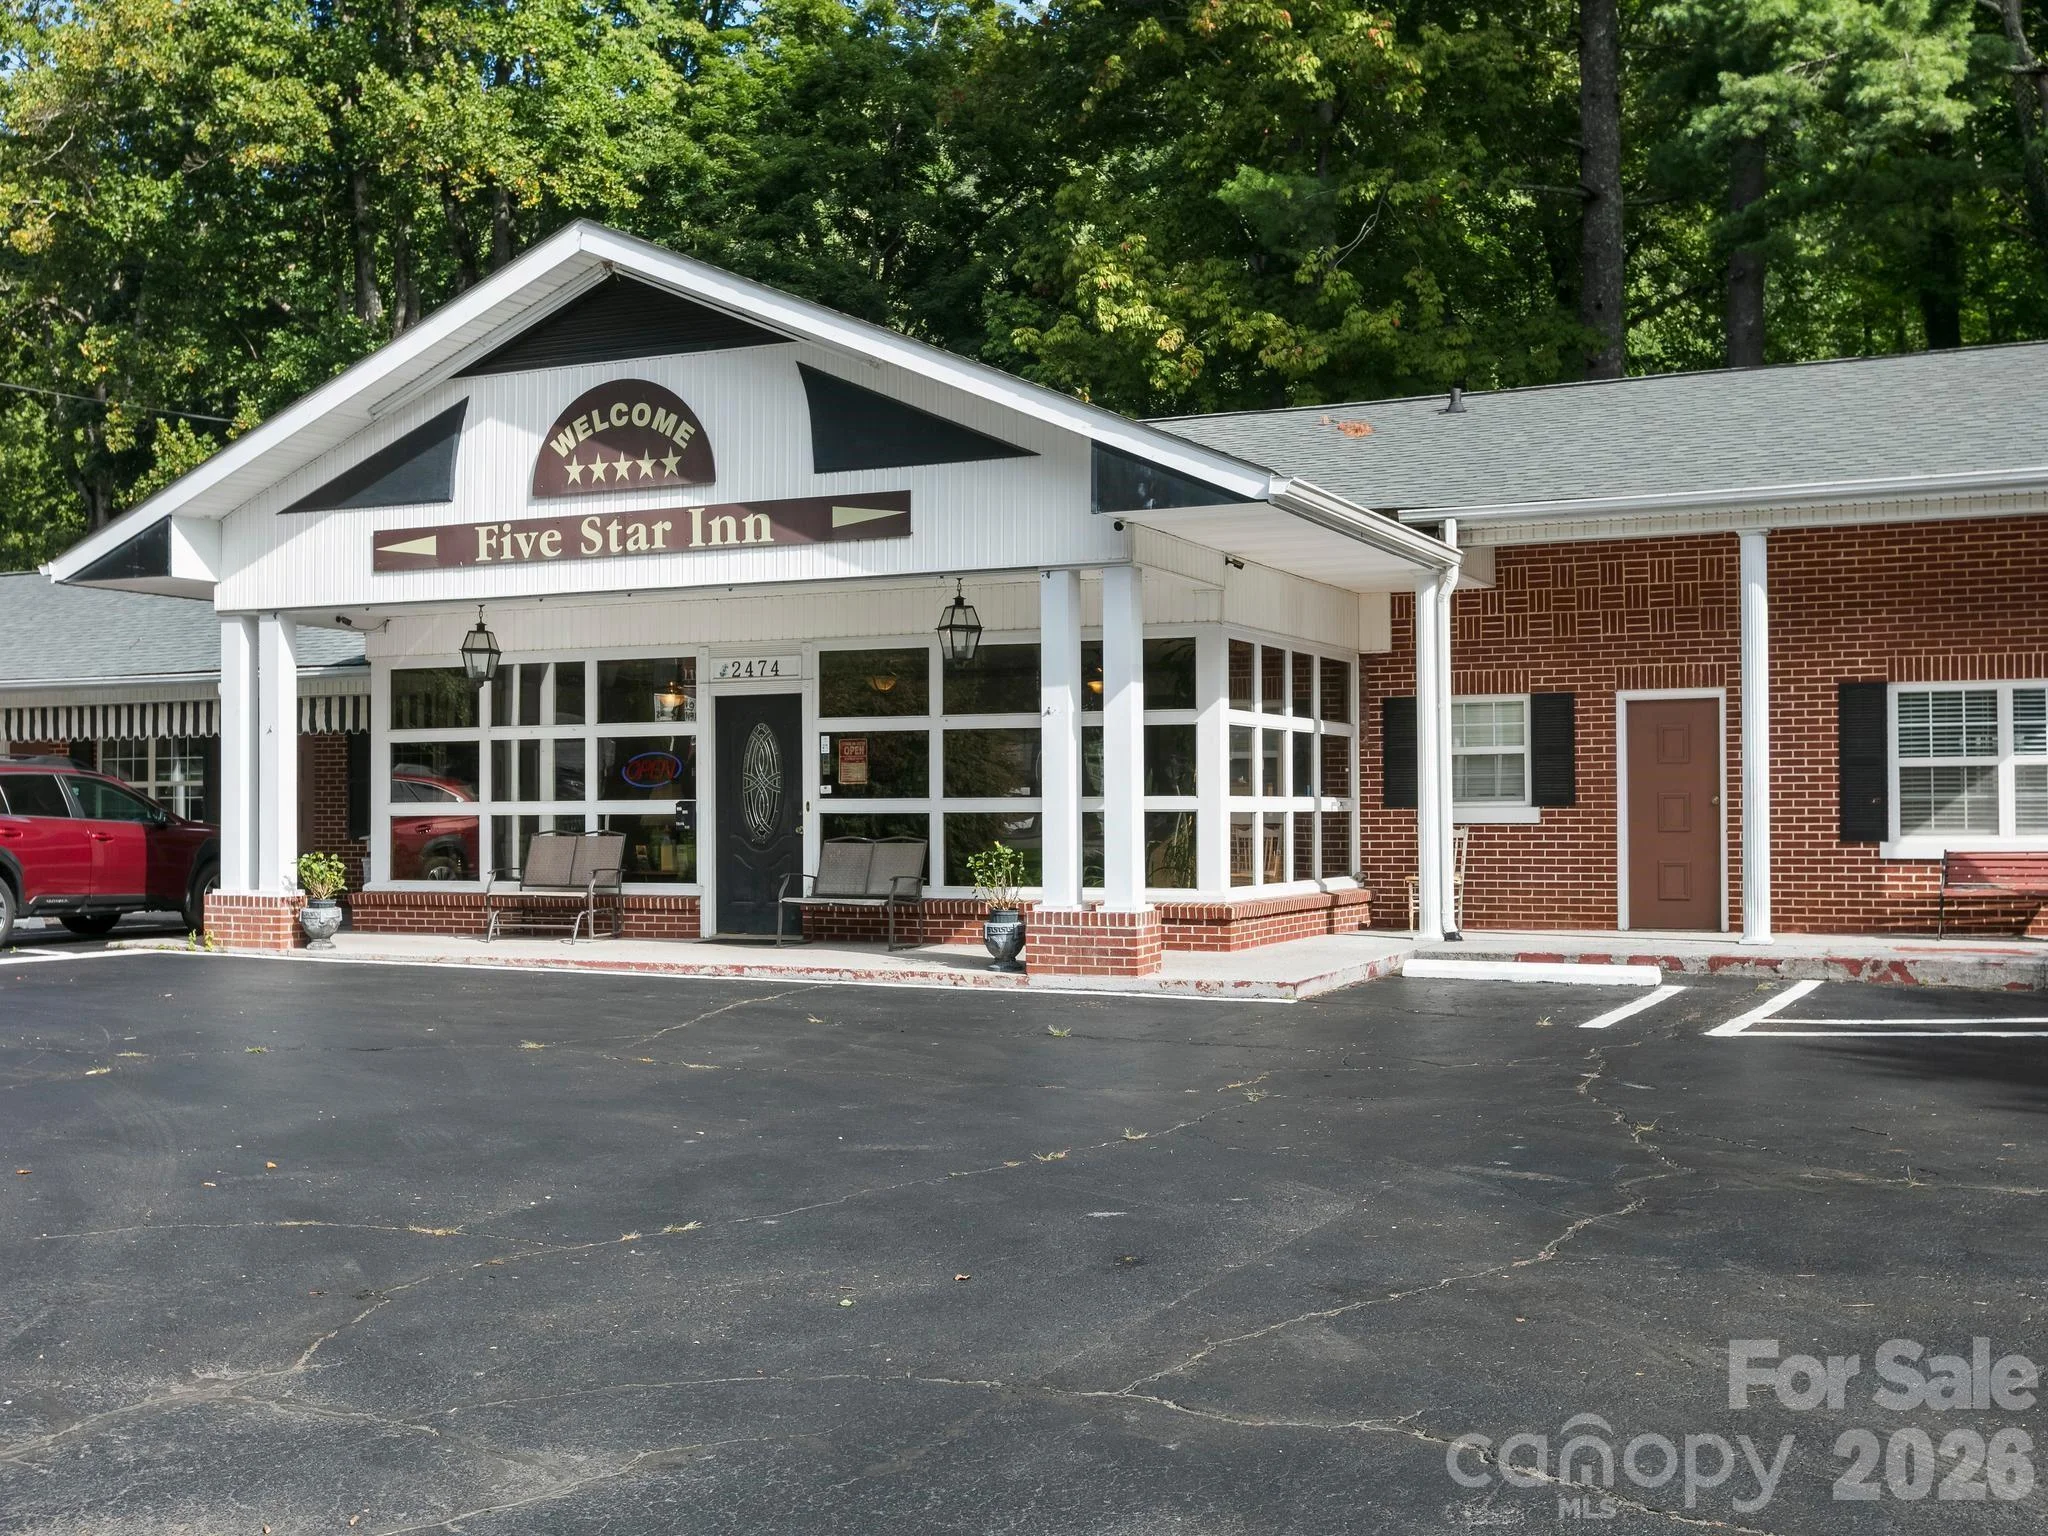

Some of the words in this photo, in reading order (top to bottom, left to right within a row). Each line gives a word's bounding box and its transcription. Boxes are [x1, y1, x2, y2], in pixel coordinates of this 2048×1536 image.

[549, 402, 696, 458] WELCOME
[474, 526, 563, 562] Five
[580, 516, 673, 555] Star
[688, 507, 775, 547] Inn
[626, 758, 676, 782] OPEN
[843, 745, 865, 756] OPEN
